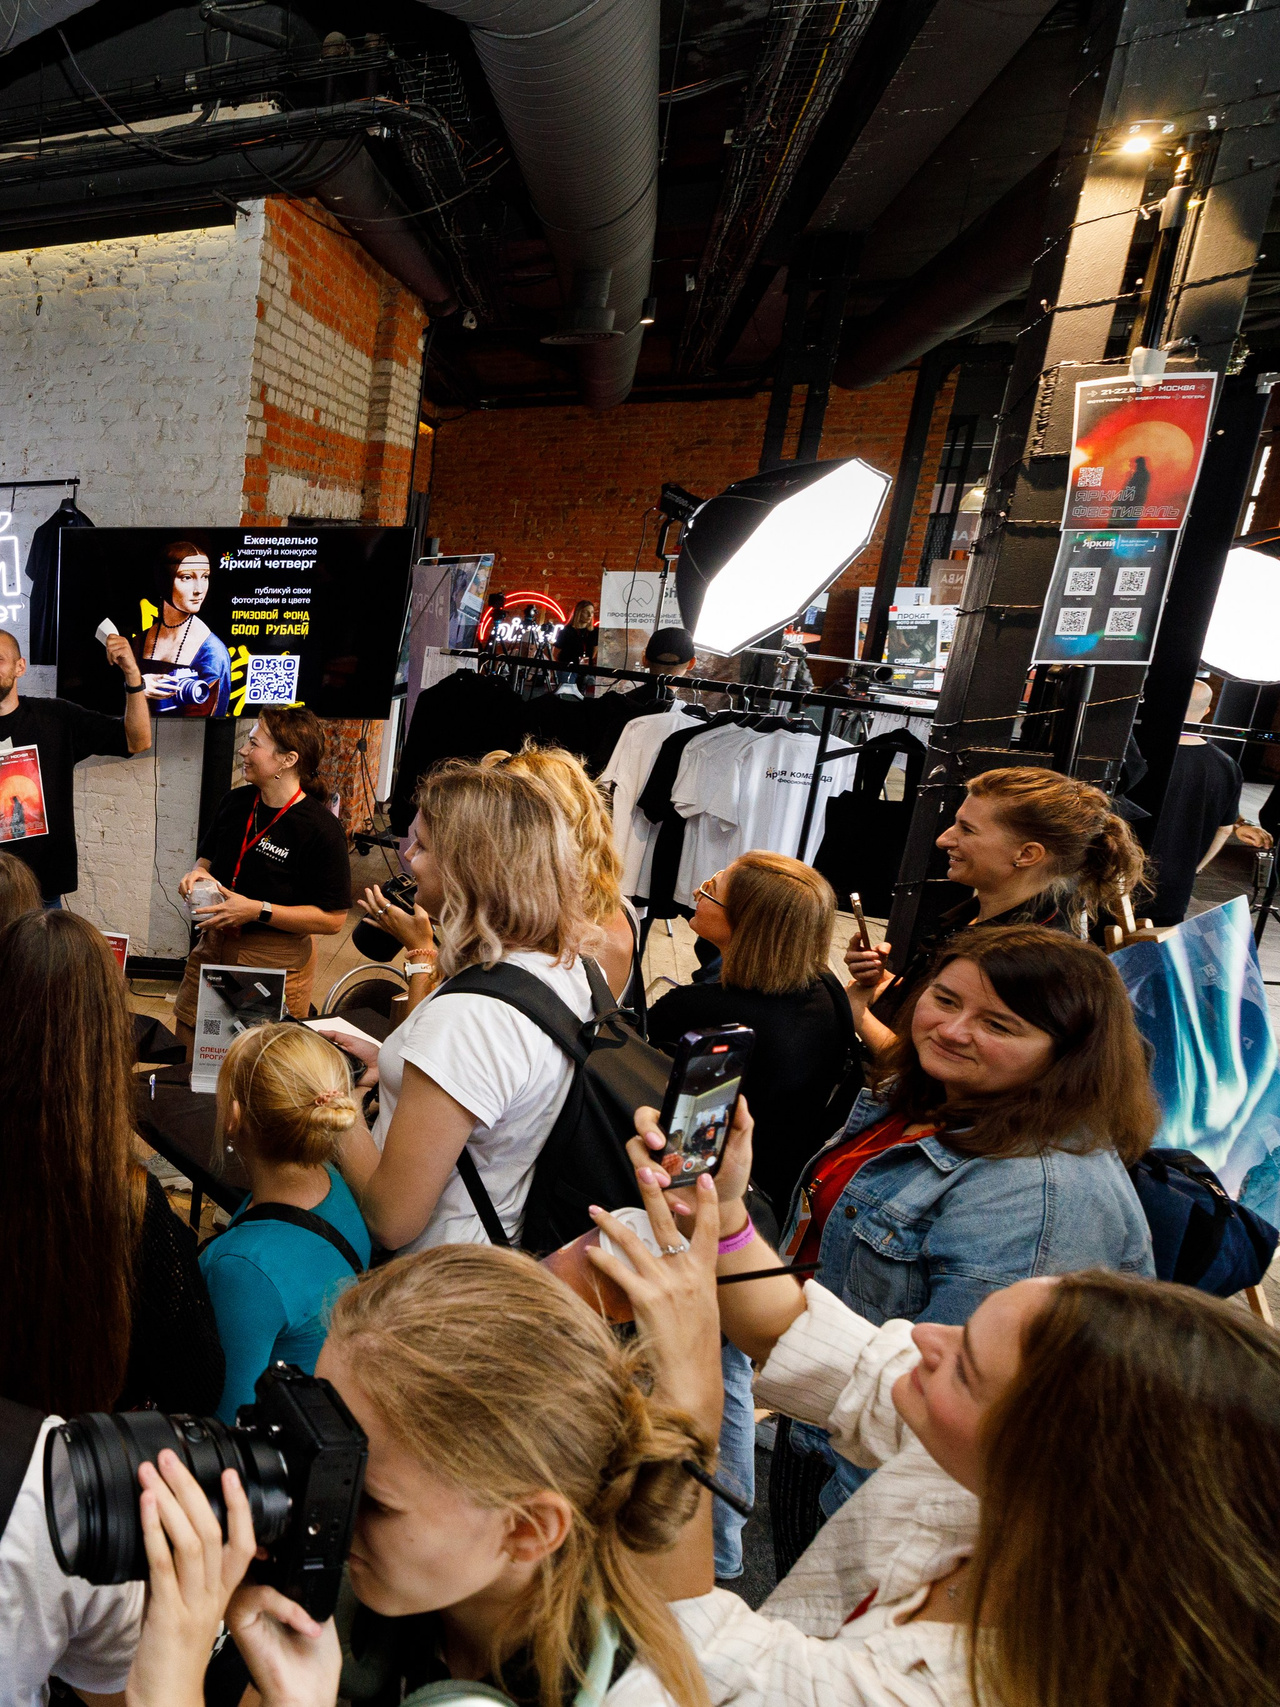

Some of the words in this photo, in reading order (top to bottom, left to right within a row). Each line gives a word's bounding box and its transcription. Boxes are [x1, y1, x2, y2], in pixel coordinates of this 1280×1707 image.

[1158, 384, 1195, 392] МОСКВА
[1075, 486, 1136, 502] ЯРКИЙ
[1072, 505, 1180, 518] ФЕСТИВАЛЬ
[243, 535, 319, 546] Еженедельно
[1082, 538, 1116, 549] Яркий
[237, 548, 272, 557] участвуй
[280, 549, 318, 557] конкурсе
[219, 556, 262, 571] Яркий
[264, 560, 317, 571] четверг
[254, 586, 291, 596] публикуй
[231, 596, 280, 606] фотографии
[288, 597, 311, 605] цвете
[231, 608, 279, 620] ПРИЗОВОЙ
[283, 610, 310, 621] ФОНД
[231, 624, 260, 636] 6000
[265, 622, 310, 636] РУБЛЕЙ
[790, 771, 833, 783] комада
[258, 836, 290, 859] Яркий
